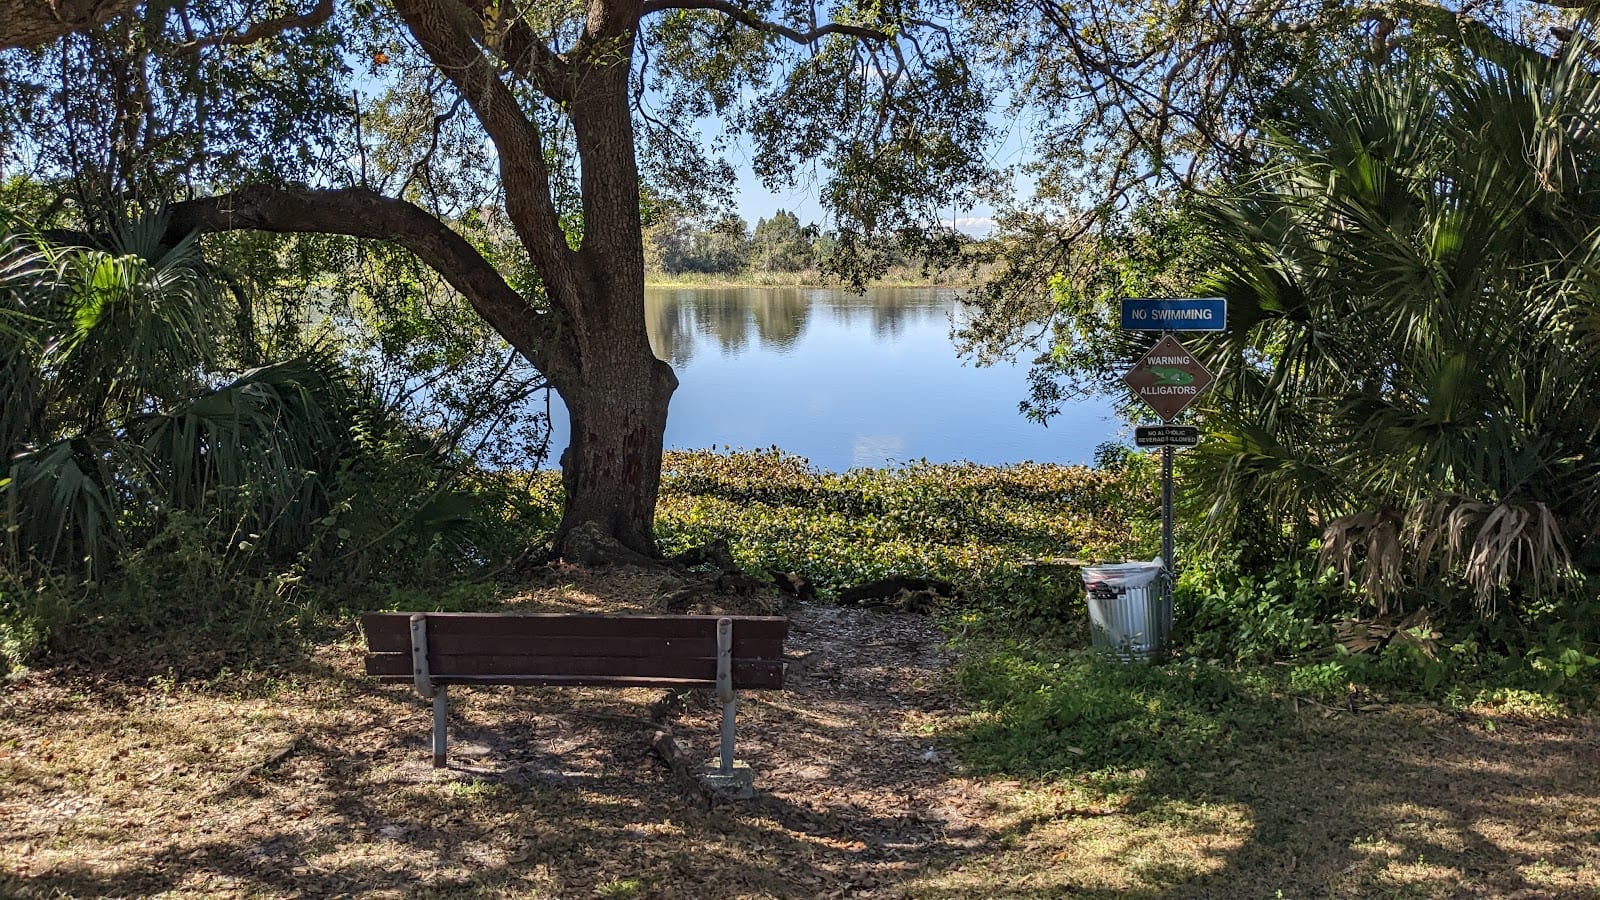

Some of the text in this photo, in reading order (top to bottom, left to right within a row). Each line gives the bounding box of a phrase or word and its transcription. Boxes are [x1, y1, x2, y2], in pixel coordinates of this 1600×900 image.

[1131, 308, 1212, 320] NO SWIMMING
[1147, 356, 1190, 365] WARNING
[1140, 386, 1197, 395] ALLIGATORS
